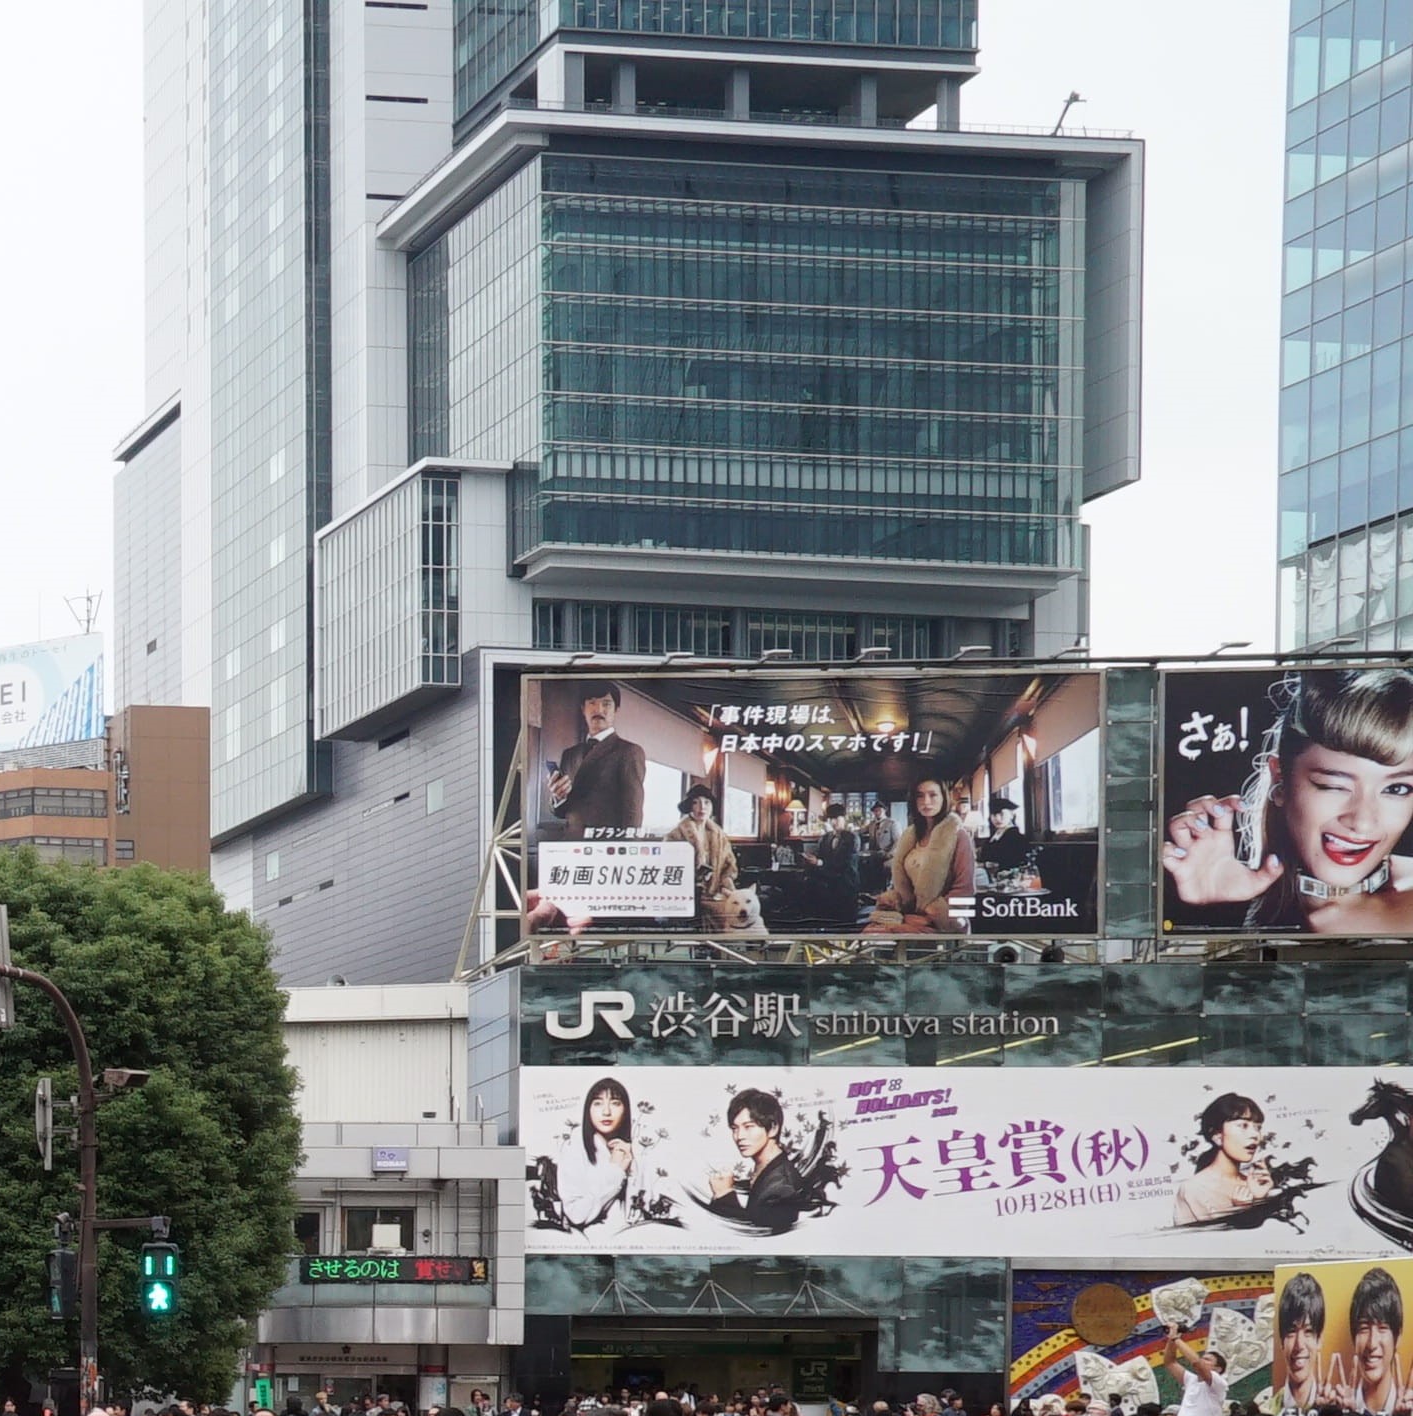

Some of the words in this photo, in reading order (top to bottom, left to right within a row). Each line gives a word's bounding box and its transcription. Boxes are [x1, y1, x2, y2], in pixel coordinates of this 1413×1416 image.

[709, 704, 836, 726] 「事件現場は、
[719, 732, 936, 755] 日本中のスマホです!」
[1178, 706, 1249, 761] さぁ!
[548, 865, 685, 886] 動画SNS放題
[981, 895, 1078, 919] SoftBank
[545, 990, 635, 1040] JR
[649, 991, 802, 1039] 渋谷駅
[815, 1011, 939, 1038] shibuya
[952, 1010, 1060, 1035] station
[847, 1078, 888, 1099] HOT
[857, 1119, 1150, 1208] 天皇賞(秋)
[994, 1183, 1121, 1217] 10月28日(日)
[308, 1258, 400, 1279] させるのは
[801, 1361, 828, 1377] JR
